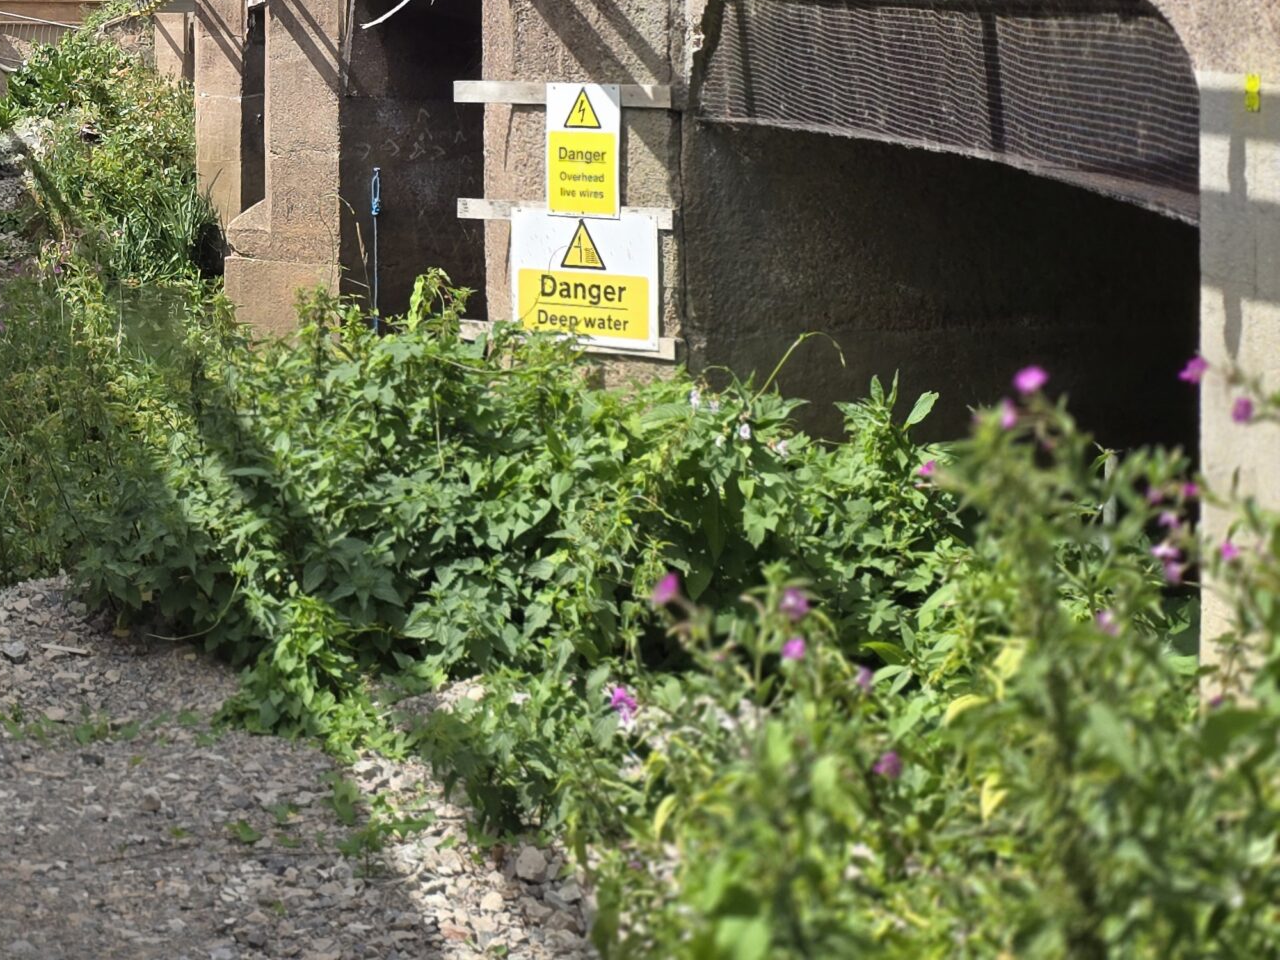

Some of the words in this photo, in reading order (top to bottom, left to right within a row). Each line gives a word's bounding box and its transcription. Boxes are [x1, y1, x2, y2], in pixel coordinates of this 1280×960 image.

[558, 146, 606, 164] Danger
[559, 171, 605, 182] Overhead
[560, 187, 577, 197] live
[579, 188, 605, 199] wires
[540, 274, 626, 305] Danger
[537, 309, 579, 328] Deep
[583, 314, 629, 331] water
